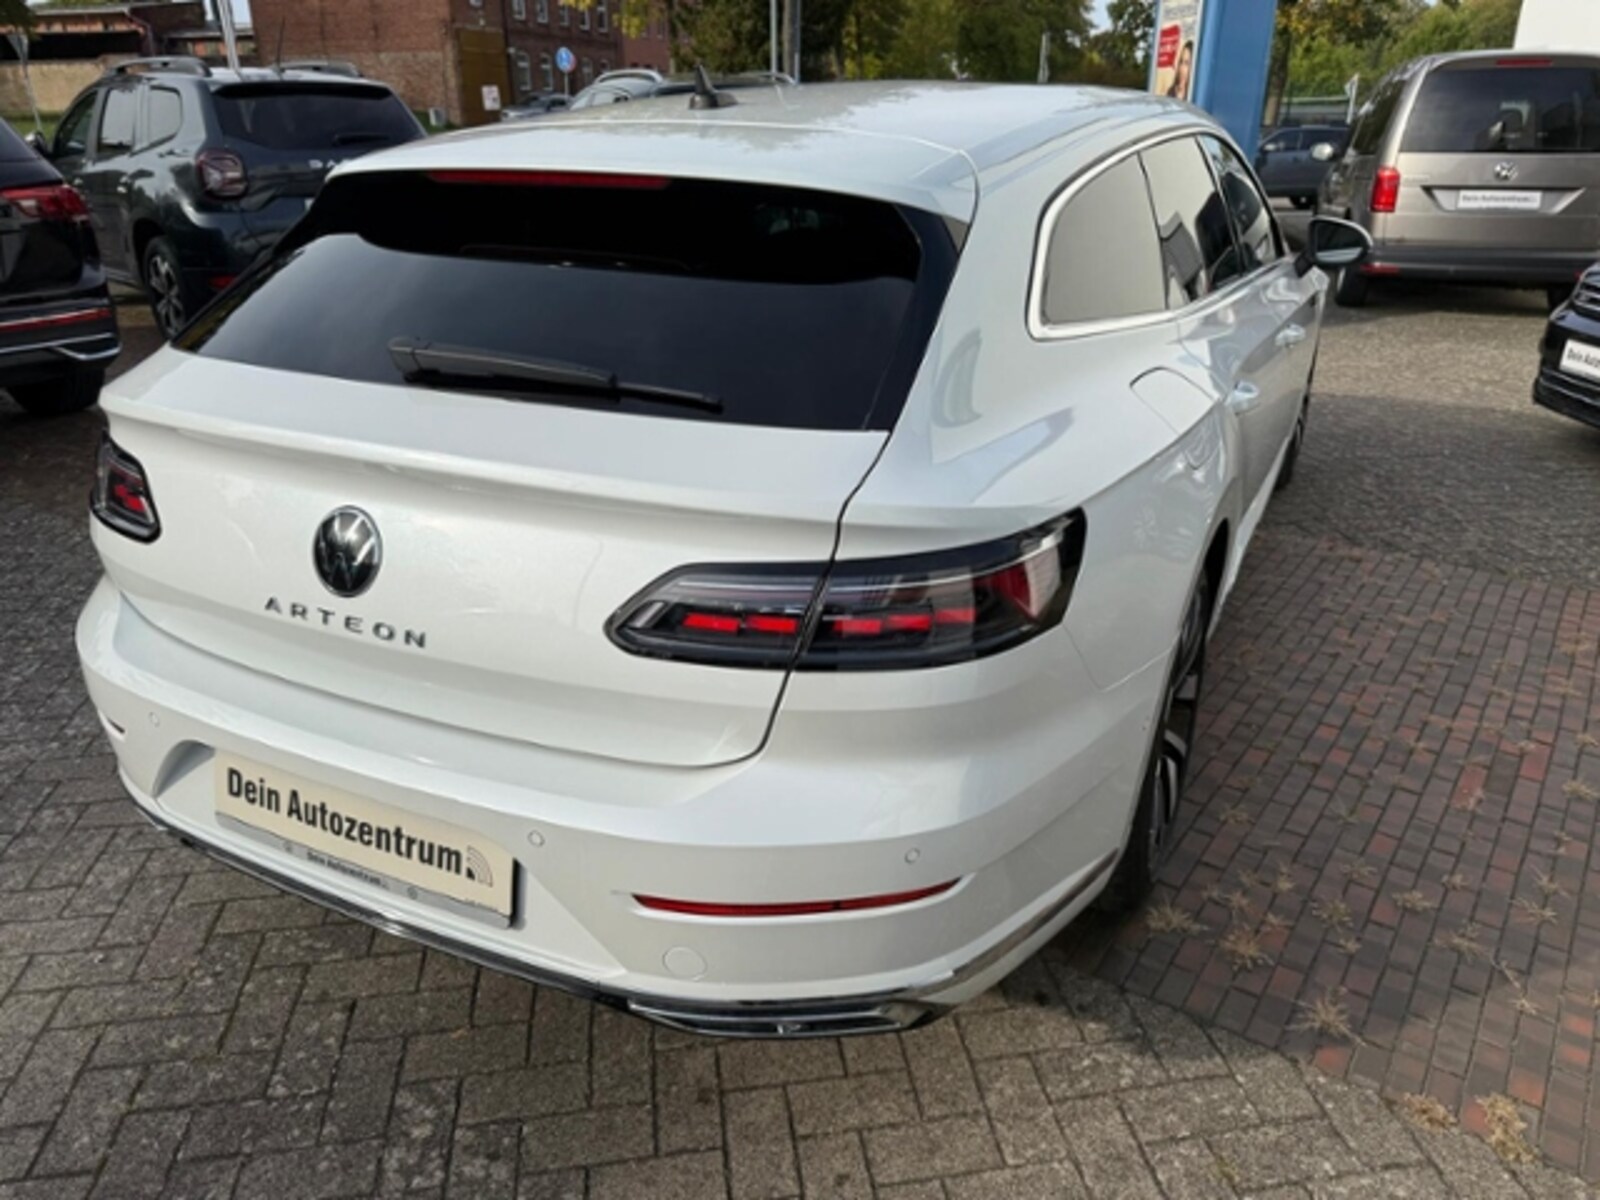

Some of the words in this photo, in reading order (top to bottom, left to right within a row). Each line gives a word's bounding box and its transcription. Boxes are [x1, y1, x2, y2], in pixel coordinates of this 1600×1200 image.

[264, 596, 427, 648] ARTEON
[226, 767, 281, 813] Dein
[287, 789, 463, 875] Autozentrum
